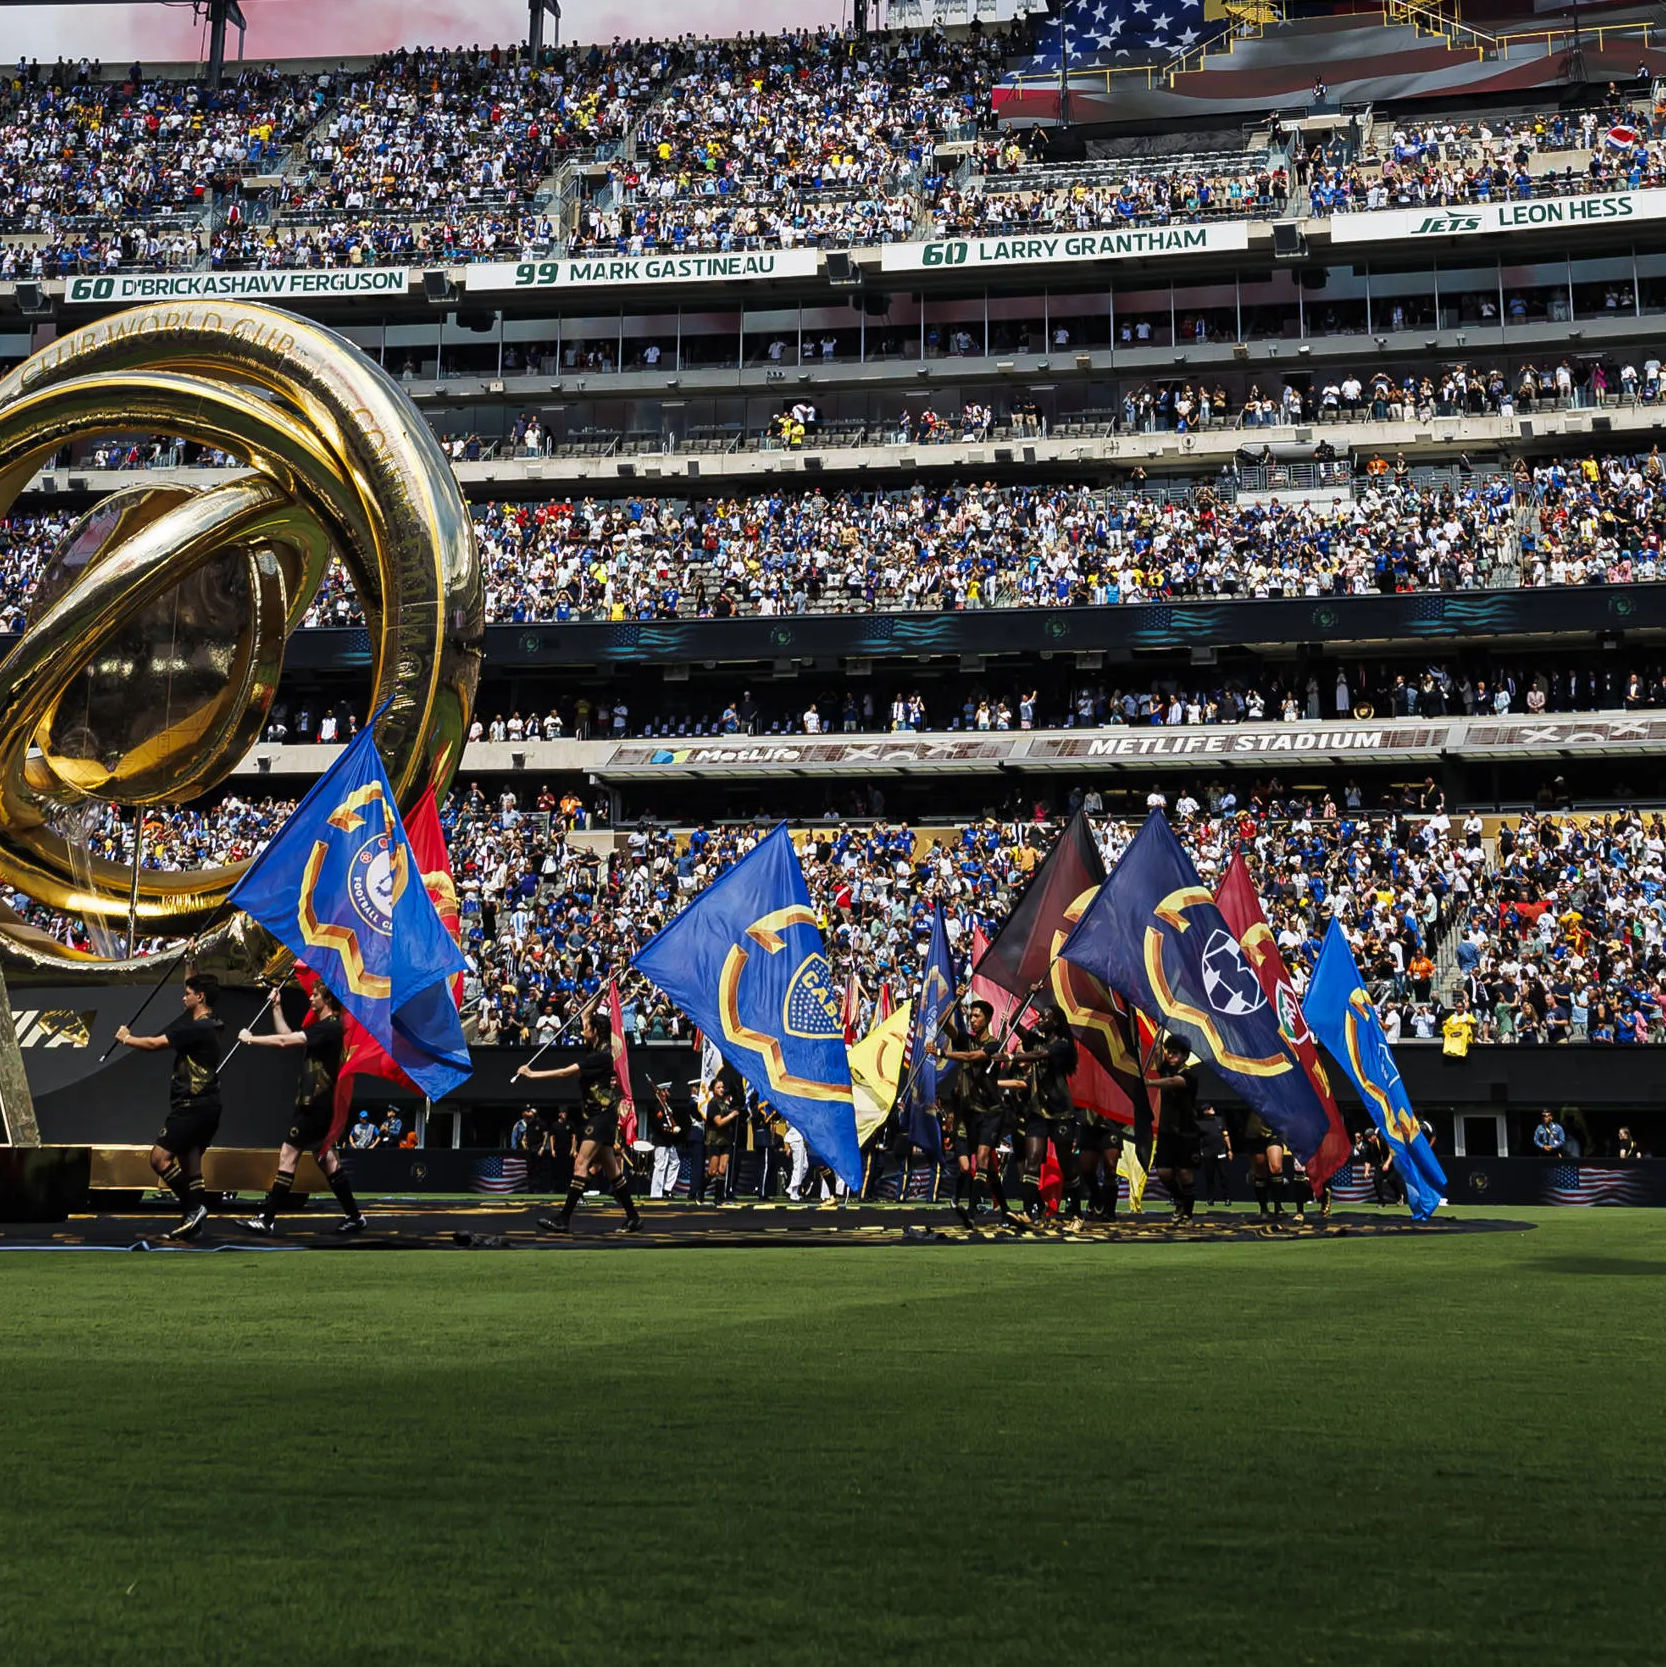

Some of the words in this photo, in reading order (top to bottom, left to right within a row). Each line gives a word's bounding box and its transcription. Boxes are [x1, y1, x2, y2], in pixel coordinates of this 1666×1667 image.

[1410, 211, 1483, 235] JETS
[1498, 202, 1562, 226] LEON
[1569, 196, 1633, 220] HESS
[921, 242, 968, 265] 60
[979, 238, 1058, 261] LARRY
[1065, 228, 1207, 258] GRANTHAM
[71, 277, 114, 300] 60
[121, 274, 286, 296] D'BRICKASHAW
[289, 271, 402, 293] FERGUSON
[516, 263, 559, 285] 99
[570, 261, 639, 282] MARK
[645, 256, 774, 279] GASTINEAU
[108, 312, 223, 349] WORLD
[232, 317, 296, 355] CUP
[695, 747, 801, 764] MetLife
[1088, 737, 1226, 755] METLIFE
[1234, 732, 1382, 752] STADIUM
[353, 876, 379, 923] FOOTBALL
